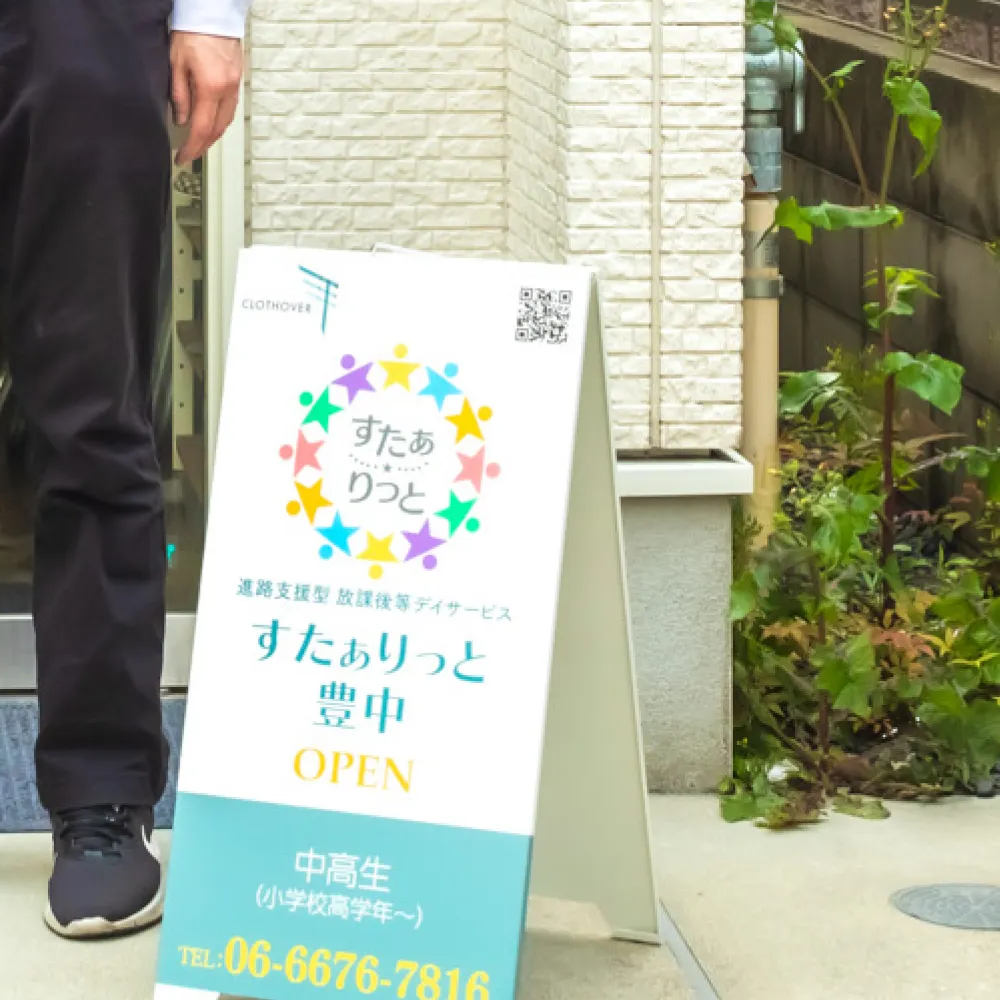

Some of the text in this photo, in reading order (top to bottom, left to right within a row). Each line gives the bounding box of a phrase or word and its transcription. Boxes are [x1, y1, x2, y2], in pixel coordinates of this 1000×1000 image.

[241, 298, 311, 314] CLOTHOVER
[348, 470, 425, 515] りっと
[236, 577, 513, 621] 進路支援型 放課後等デイサービス
[252, 618, 487, 683] すたぁりっと
[312, 680, 405, 734] 豊中
[293, 746, 414, 793] OPEN
[294, 847, 392, 893] 中高生
